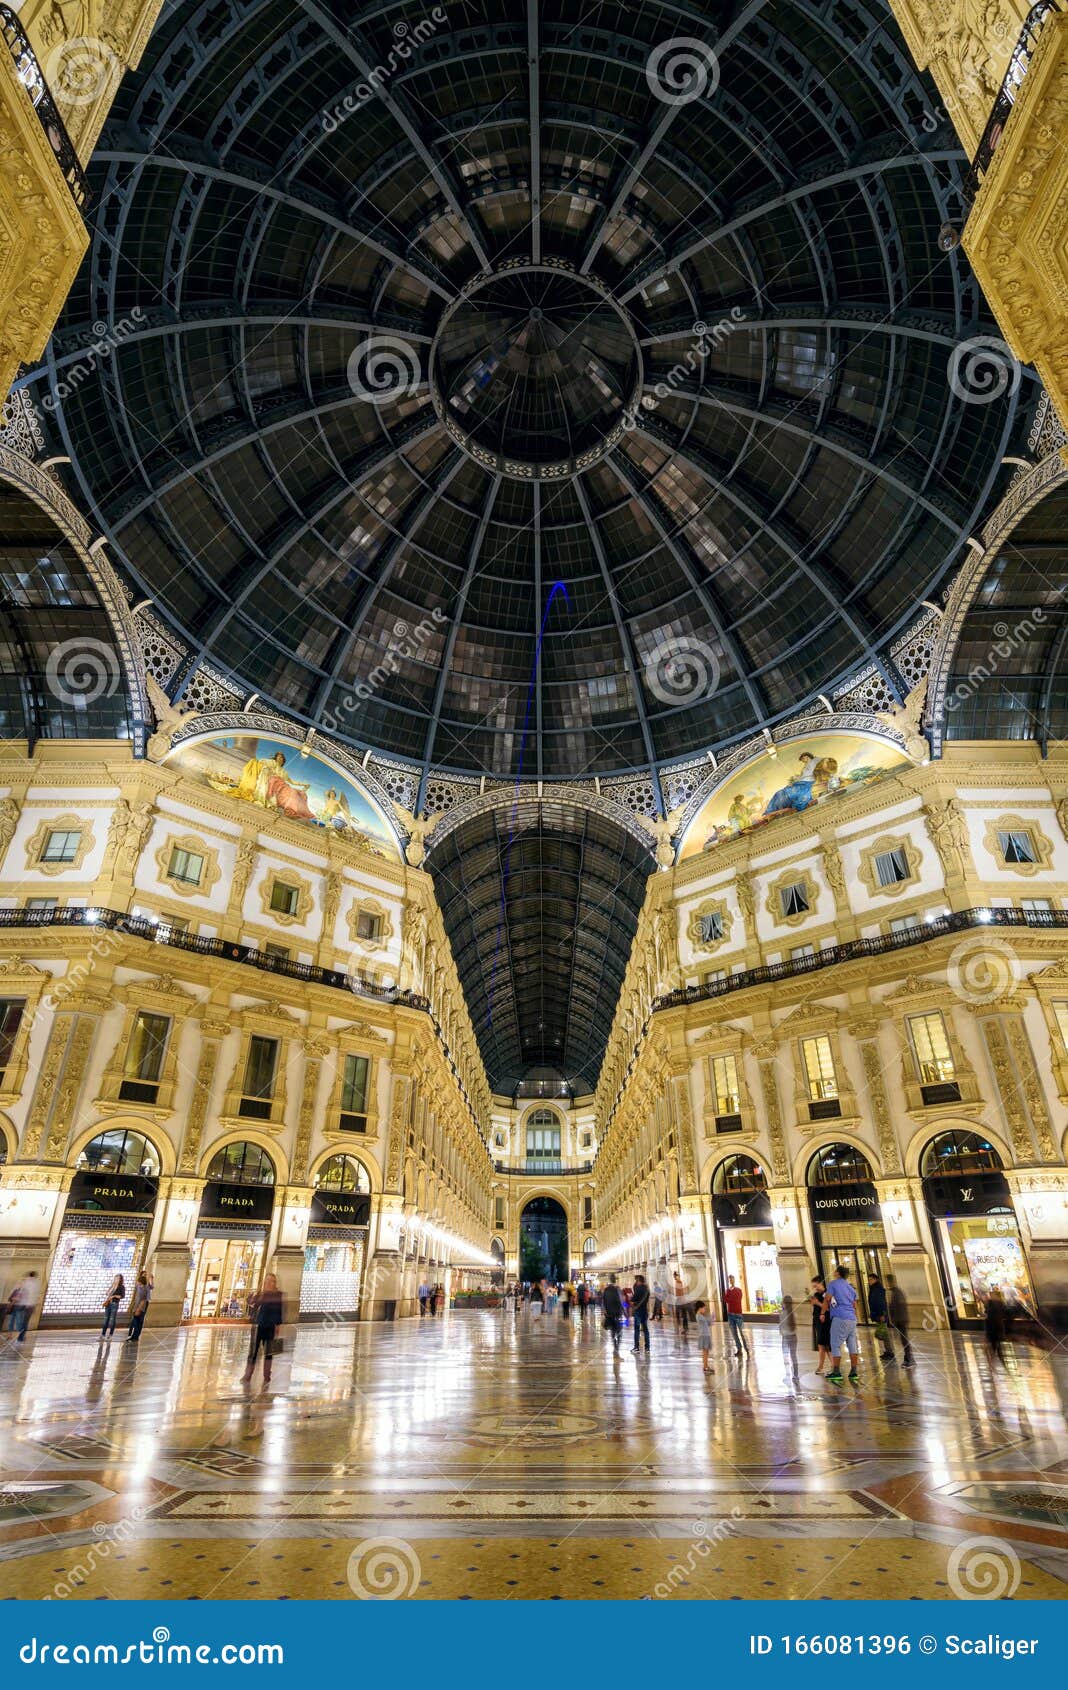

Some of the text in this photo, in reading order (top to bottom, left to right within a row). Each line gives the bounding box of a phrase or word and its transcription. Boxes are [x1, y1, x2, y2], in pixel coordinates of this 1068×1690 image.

[94, 1187, 135, 1198] PRADA
[220, 1197, 254, 1207] PRADA
[815, 1196, 875, 1209] LOUIS VUITTON
[326, 1204, 355, 1213] PRADA
